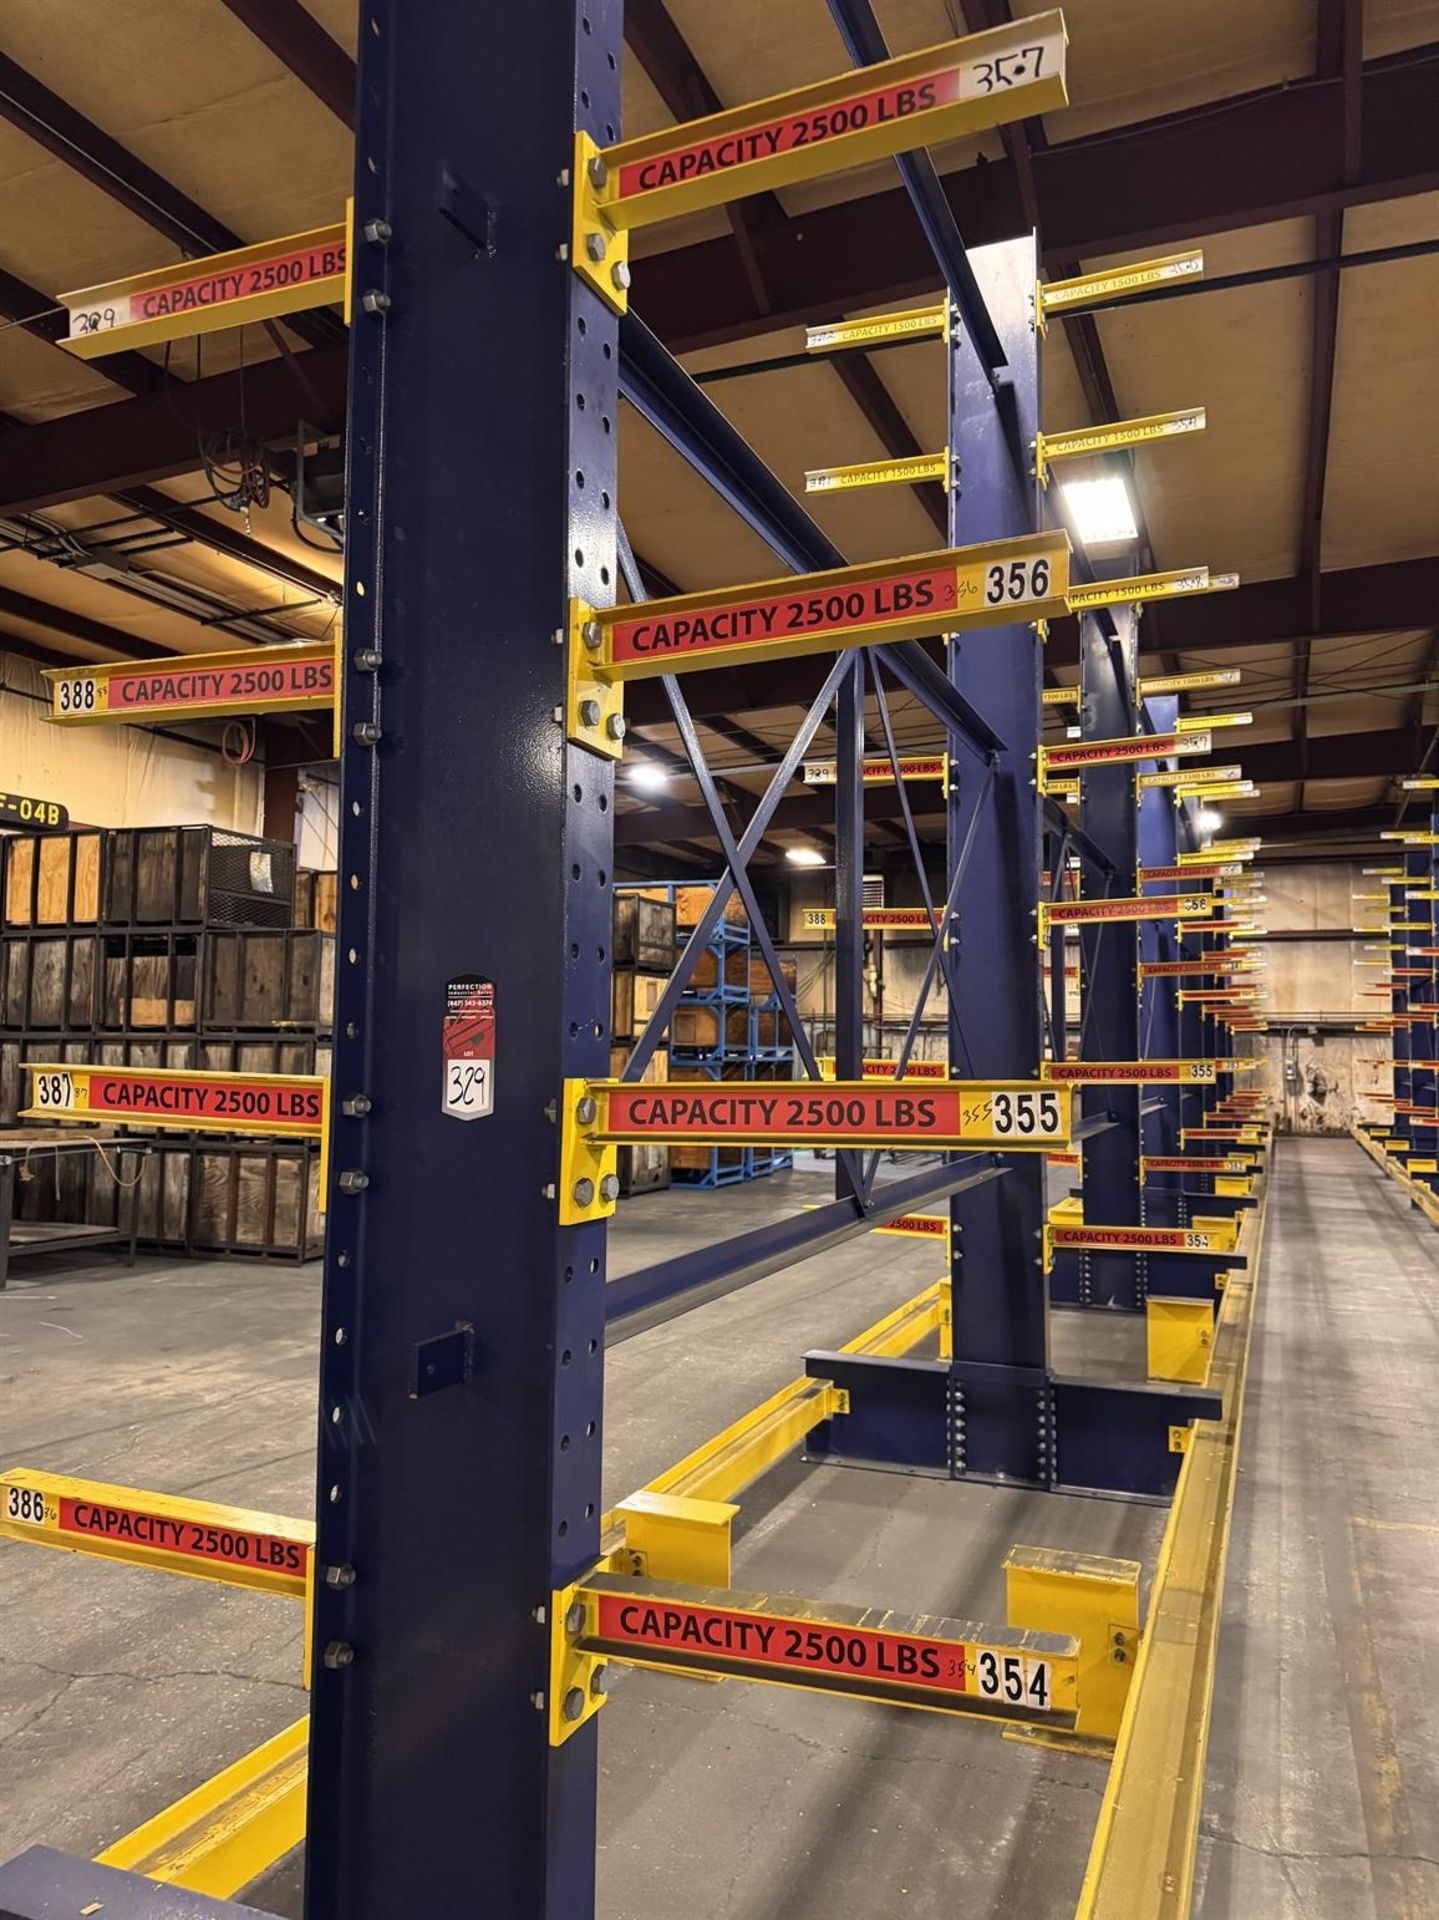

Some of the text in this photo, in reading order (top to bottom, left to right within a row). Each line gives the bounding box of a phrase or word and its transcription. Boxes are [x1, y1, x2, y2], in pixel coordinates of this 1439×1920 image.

[639, 83, 936, 190] CAPACITY 2500 LBS
[143, 248, 347, 318] CAPACITY 2500 LBS
[1112, 276, 1138, 287] 1500
[842, 316, 937, 340] CAPACITY 1500 LBS
[1056, 425, 1163, 451] CAPACITY 1500 LBS
[841, 463, 936, 485] CAPACITY 1500 LBS
[987, 559, 1049, 603] 356
[1115, 585, 1141, 598] 1500
[1145, 582, 1166, 594] LBS
[631, 579, 934, 652] CAPACITY 2500 LBS
[60, 680, 94, 711] 388
[122, 674, 225, 703] CAPACITY
[230, 670, 284, 695] 2500
[290, 664, 333, 690] LBS
[1057, 740, 1168, 764] CAPACITY 2500 LBS
[917, 763, 936, 773] LBS
[808, 912, 826, 926] 388
[890, 914, 914, 924] 2500
[1058, 904, 1113, 920] CAPACITY
[1117, 902, 1145, 915] 2500
[917, 1066, 937, 1077] LBS
[1059, 1067, 1173, 1079] CAPACITY 2500 LBS
[1191, 1065, 1213, 1078] 355
[38, 1073, 71, 1107] 387
[103, 1082, 320, 1118] CAPACITY 2500 LBS
[448, 1066, 487, 1106] 329
[628, 1098, 937, 1128] CAPACITY 2500 LBS
[995, 1093, 1059, 1133] 355
[917, 1220, 937, 1232] LBS
[1064, 1231, 1177, 1246] CAPACITY 2500 LBS
[9, 1487, 44, 1522] 386
[74, 1505, 300, 1569] CAPACITY 2500 LBS
[620, 1606, 941, 1679] CAPACITY 2500 LBS
[979, 1652, 1048, 1706] 354
